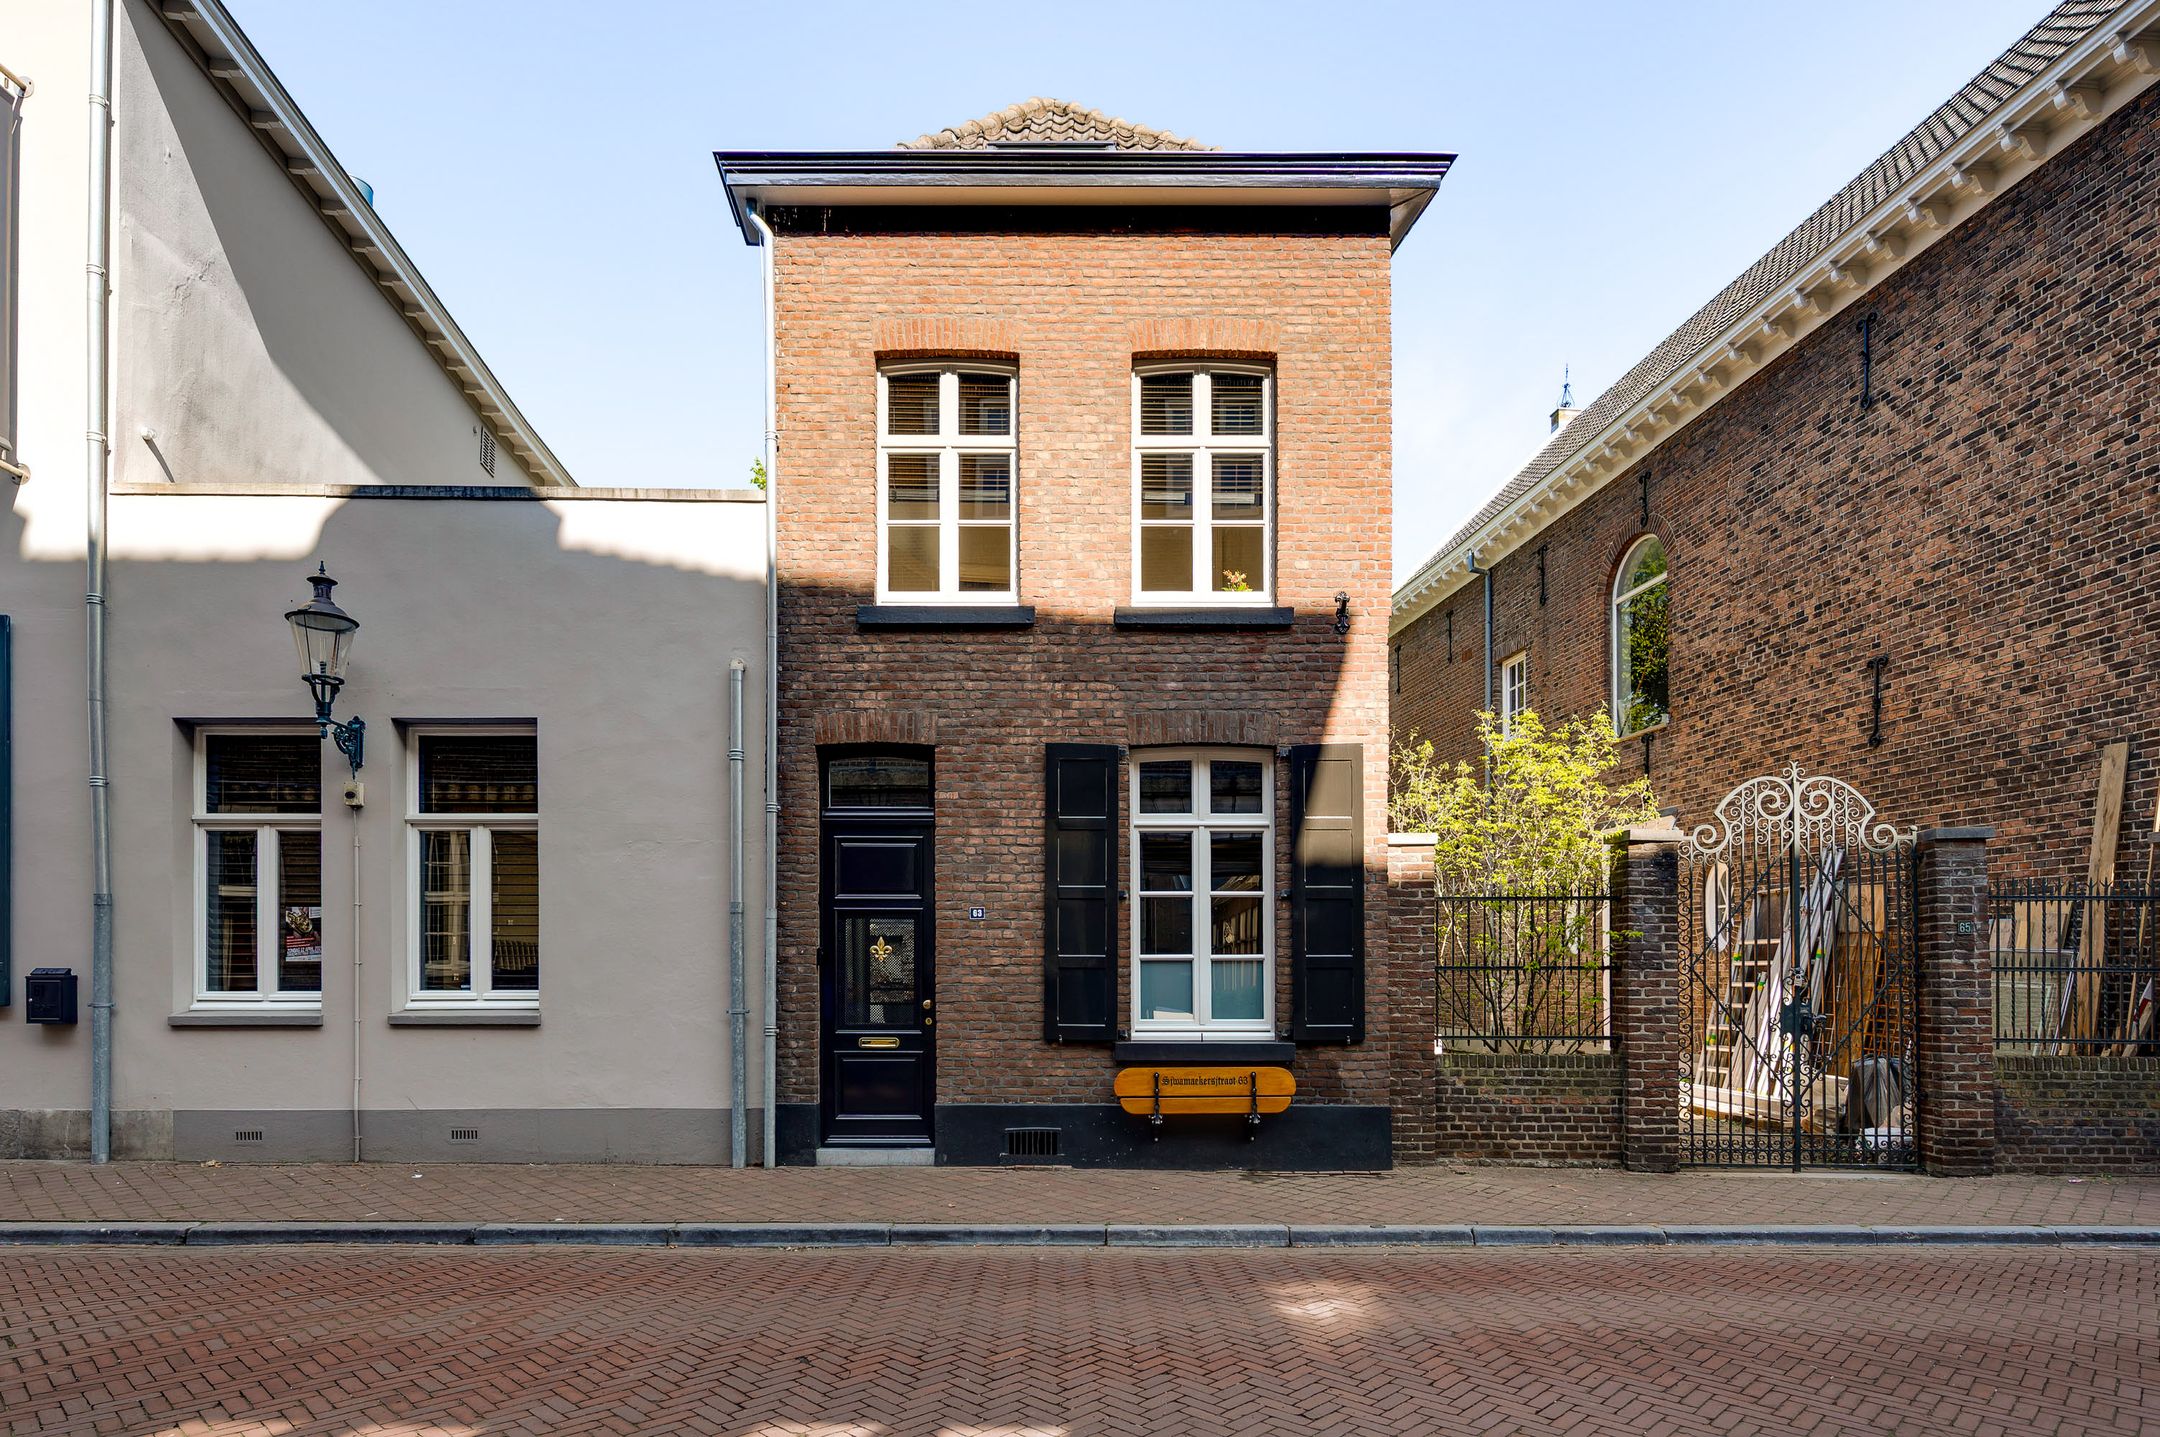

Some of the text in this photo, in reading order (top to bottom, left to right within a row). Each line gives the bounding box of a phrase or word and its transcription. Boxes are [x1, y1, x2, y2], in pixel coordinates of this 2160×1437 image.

[973, 909, 982, 917] 63
[1960, 922, 1970, 932] 65
[1238, 1076, 1249, 1085] 63
